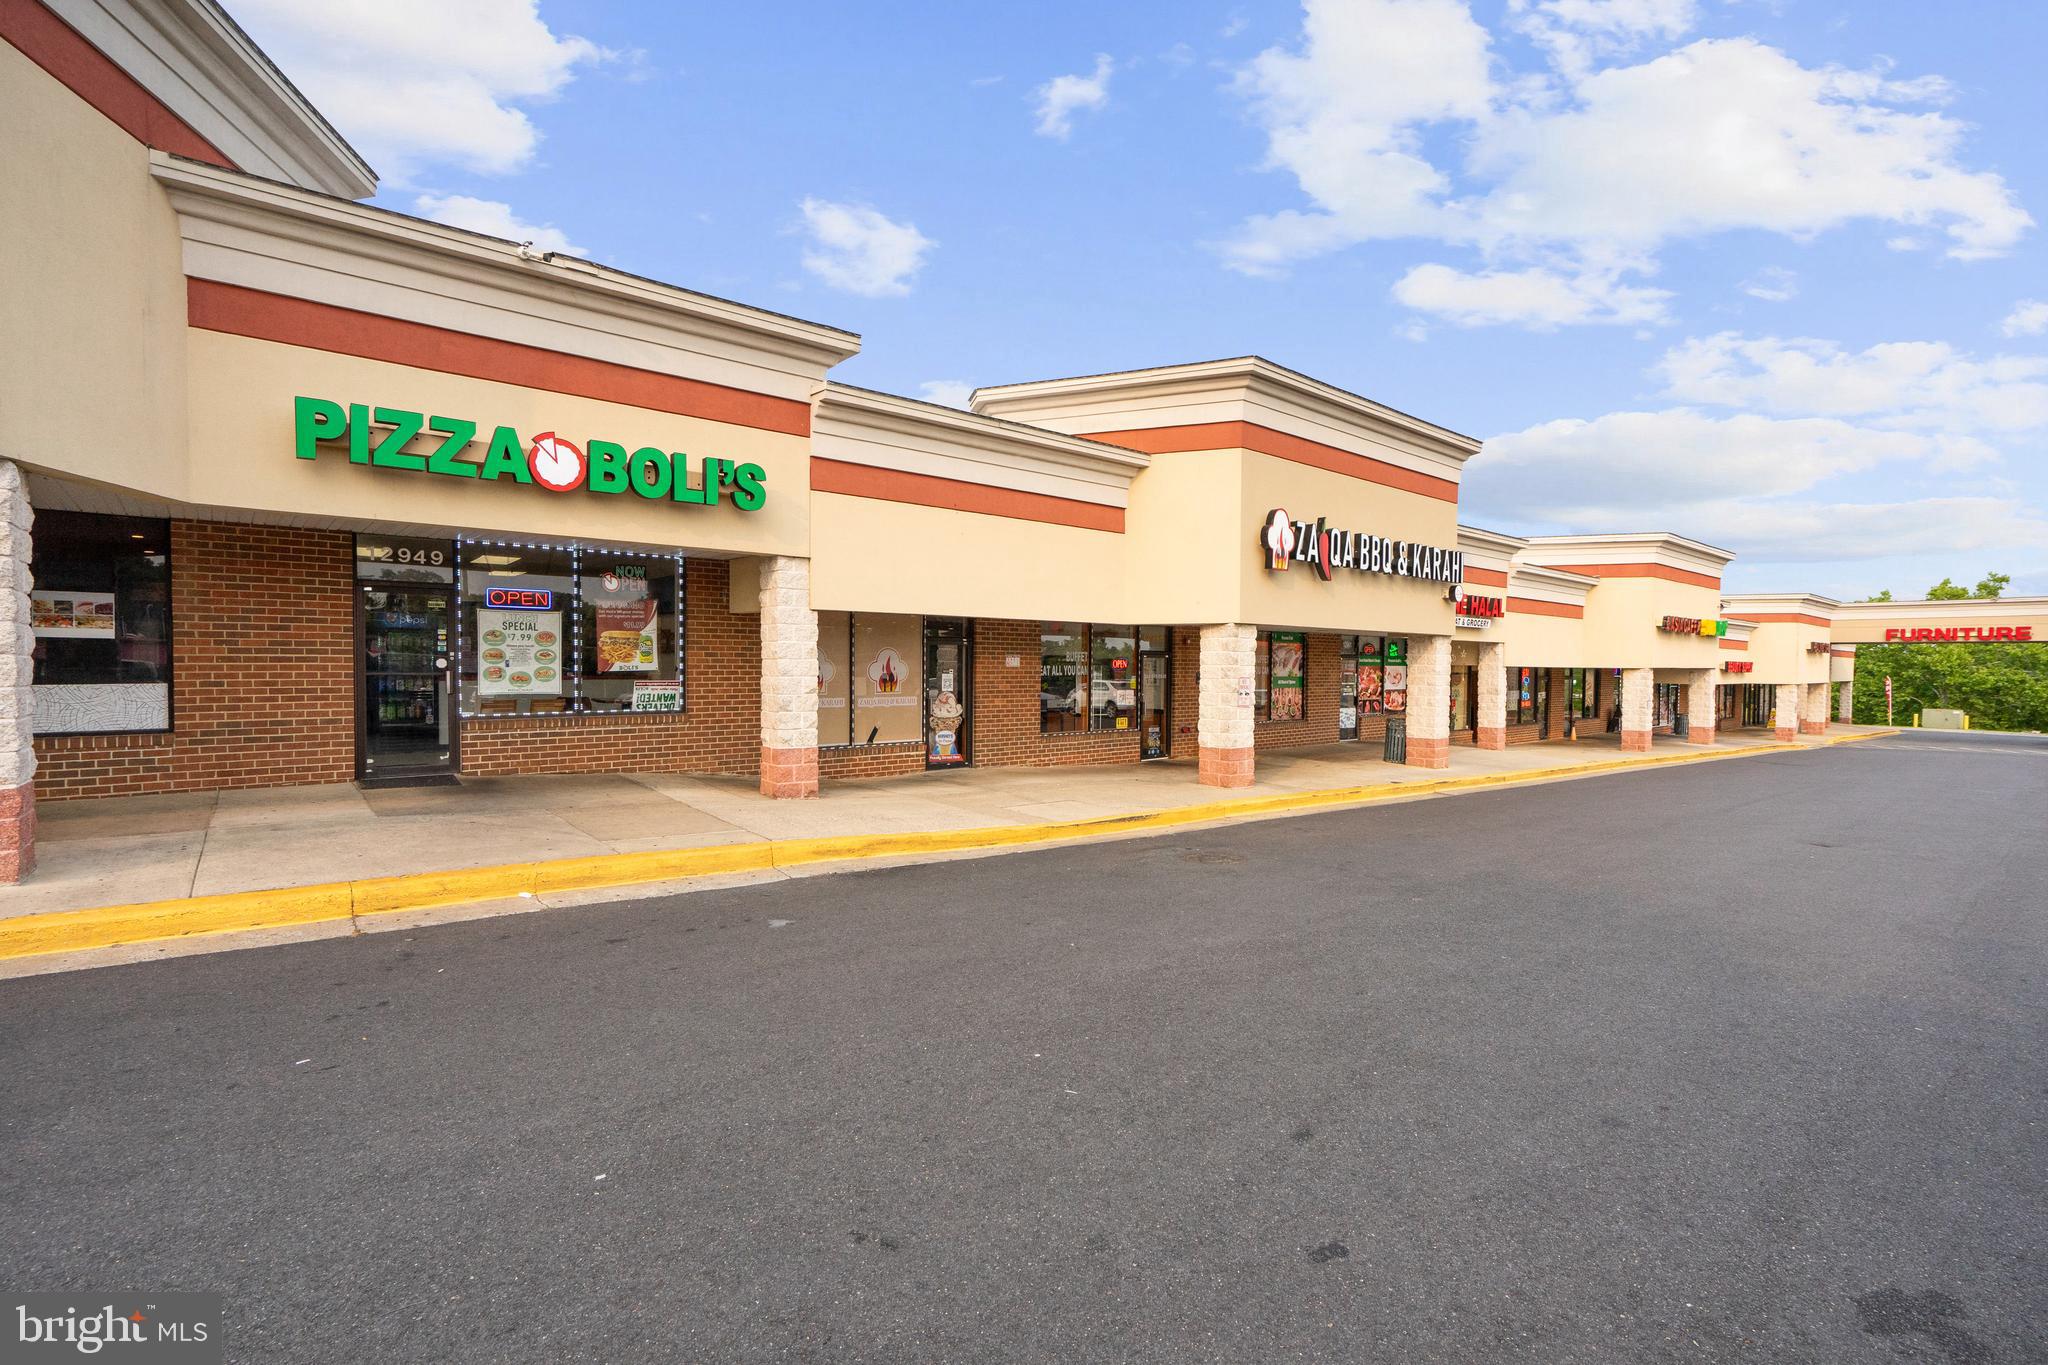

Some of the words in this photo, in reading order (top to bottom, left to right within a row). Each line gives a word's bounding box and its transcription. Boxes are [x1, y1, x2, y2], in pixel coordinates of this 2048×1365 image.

[295, 396, 532, 484] PIZZA
[587, 439, 766, 511] BOLI'S
[368, 546, 444, 565] 12949
[1355, 533, 1393, 575] BBQ
[1394, 541, 1409, 575] &
[1409, 543, 1464, 583] KARAHI
[615, 565, 646, 577] NOW
[490, 590, 548, 606] OPEN
[1471, 595, 1504, 617] HALAL
[502, 621, 539, 631] SPECIAL
[1467, 619, 1489, 627] GROCERY
[1886, 626, 2032, 642] FURNITURE
[1052, 665, 1062, 676] ALL
[1063, 665, 1075, 676] YOU
[1112, 659, 1128, 669] OPEN
[636, 693, 676, 703] WANTED!
